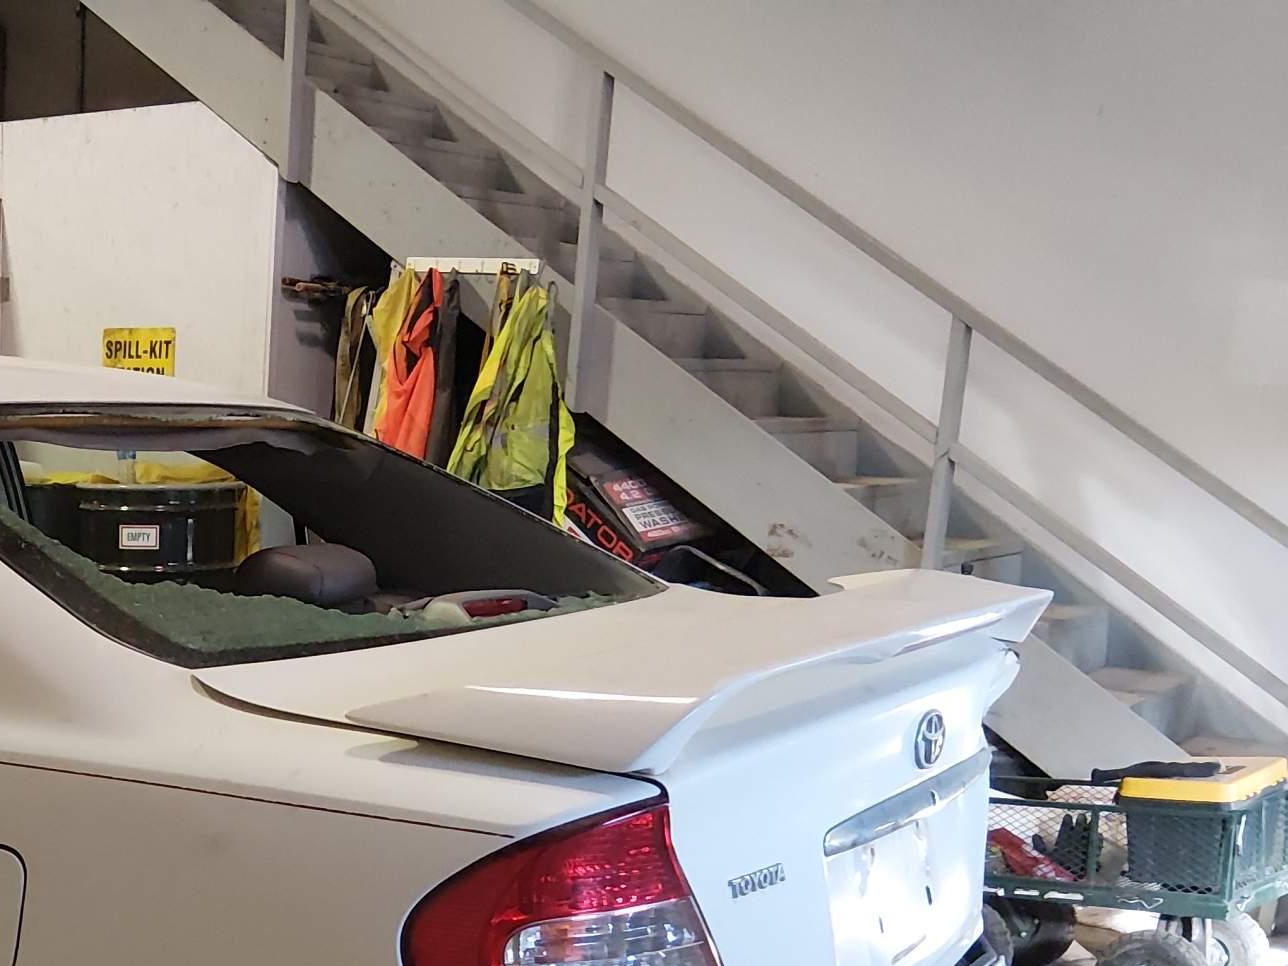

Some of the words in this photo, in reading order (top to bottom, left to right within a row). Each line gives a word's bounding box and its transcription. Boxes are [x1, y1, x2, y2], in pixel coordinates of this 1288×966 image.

[105, 340, 172, 360] SPILL-KIT
[127, 532, 151, 542] EMPTY
[728, 863, 786, 899] TOYOTA
